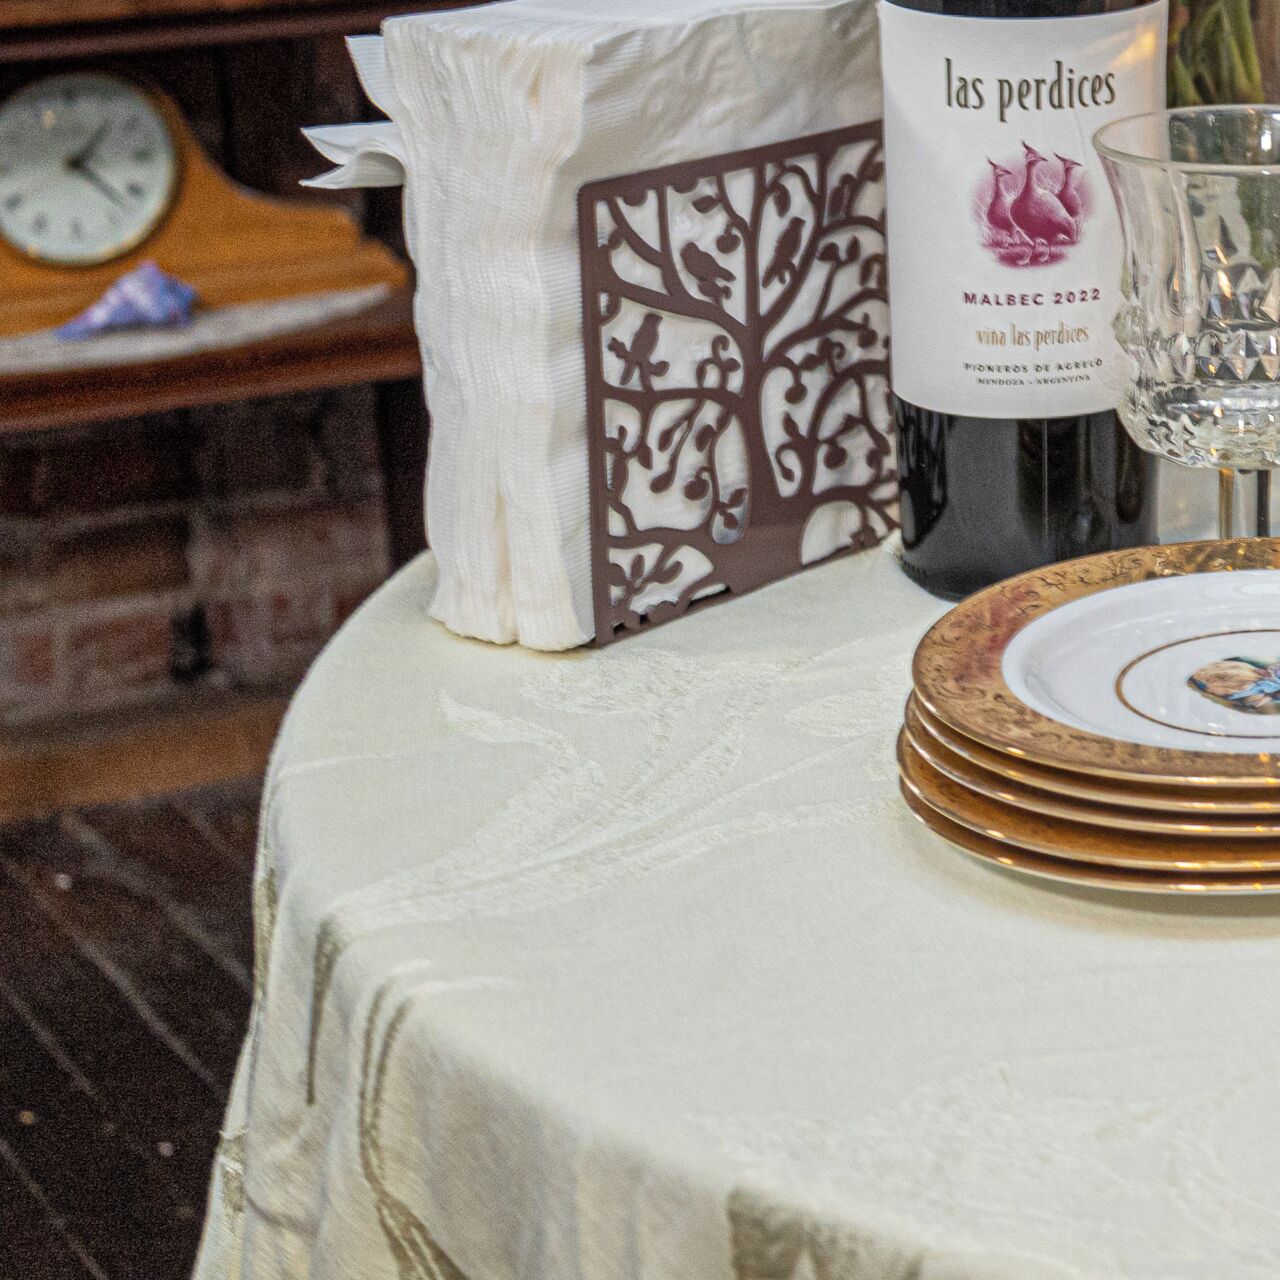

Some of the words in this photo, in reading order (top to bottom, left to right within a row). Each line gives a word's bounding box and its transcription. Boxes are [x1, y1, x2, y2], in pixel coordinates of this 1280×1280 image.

[944, 57, 985, 110] las
[997, 59, 1116, 123] perdices
[963, 291, 1045, 307] MALBEC
[1053, 288, 1102, 305] 2022
[1010, 322, 1031, 347] las
[1034, 320, 1090, 352] perdices
[963, 362, 1028, 374] PIONEROS
[1035, 364, 1050, 373] DE
[1057, 358, 1103, 372] AGRELO
[976, 377, 1025, 387] MENDOZA
[1036, 374, 1091, 386] ARGENTINA
